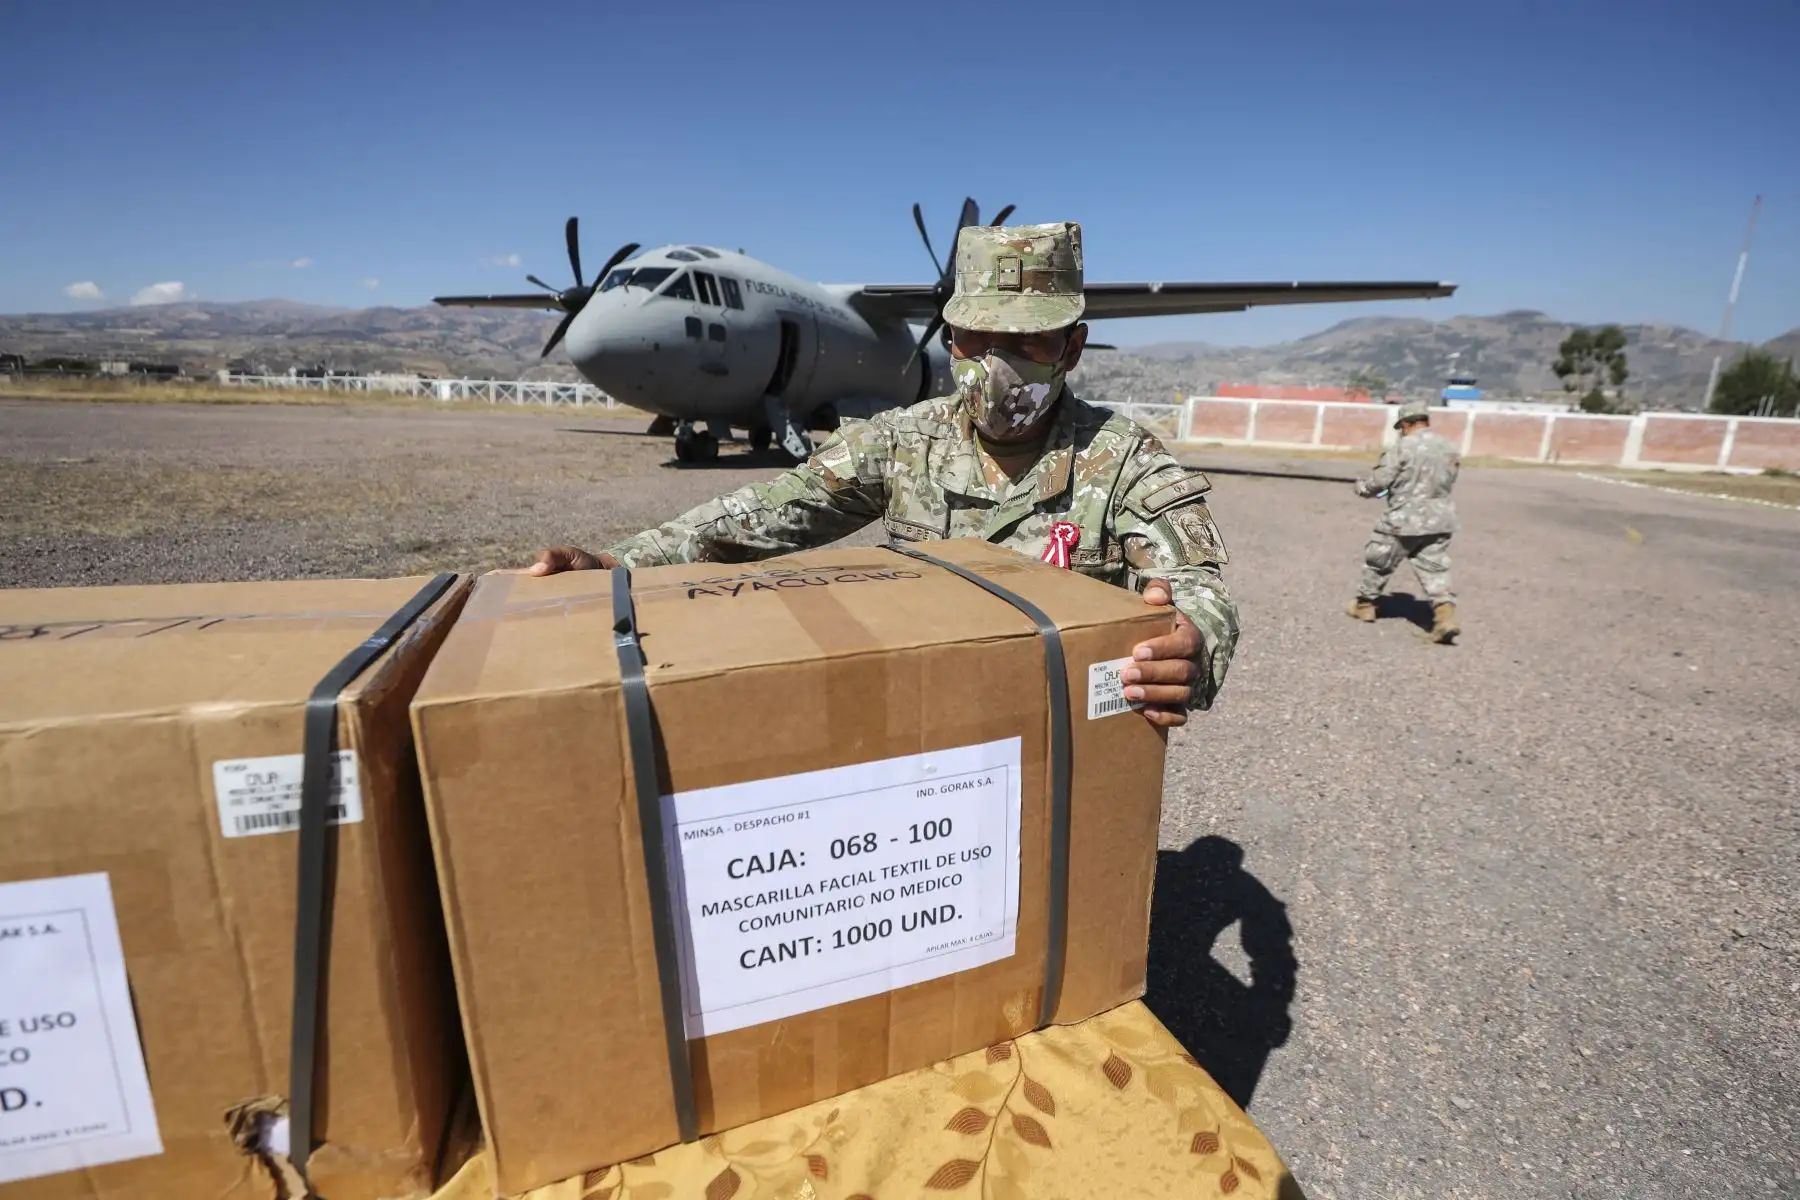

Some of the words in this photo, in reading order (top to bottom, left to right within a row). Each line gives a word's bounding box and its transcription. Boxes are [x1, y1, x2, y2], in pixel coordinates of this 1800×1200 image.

[745, 279, 787, 297] FUERZA
[687, 571, 922, 600] AYACUCHO
[916, 787, 937, 799] IND.
[940, 780, 974, 794] GORAK
[977, 776, 995, 787] S.A.
[684, 825, 724, 841] MINSA
[734, 813, 795, 832] DESPACHO
[797, 810, 811, 820] #1
[727, 848, 806, 880] CAJA:
[830, 832, 878, 860] 068
[908, 817, 953, 844] 100
[701, 883, 815, 918] MASCARILLA
[820, 870, 877, 893] FACIAL
[880, 858, 932, 881] TEXTIL
[936, 853, 956, 868] DE
[961, 845, 992, 863] USO
[738, 896, 865, 933] COMUNITARIO
[870, 888, 895, 905] NO
[900, 873, 963, 898] MEDICO
[739, 935, 822, 970] CANT:
[832, 918, 893, 950] 1000
[901, 904, 963, 933] UND.
[19, 1011, 77, 1034] USO
